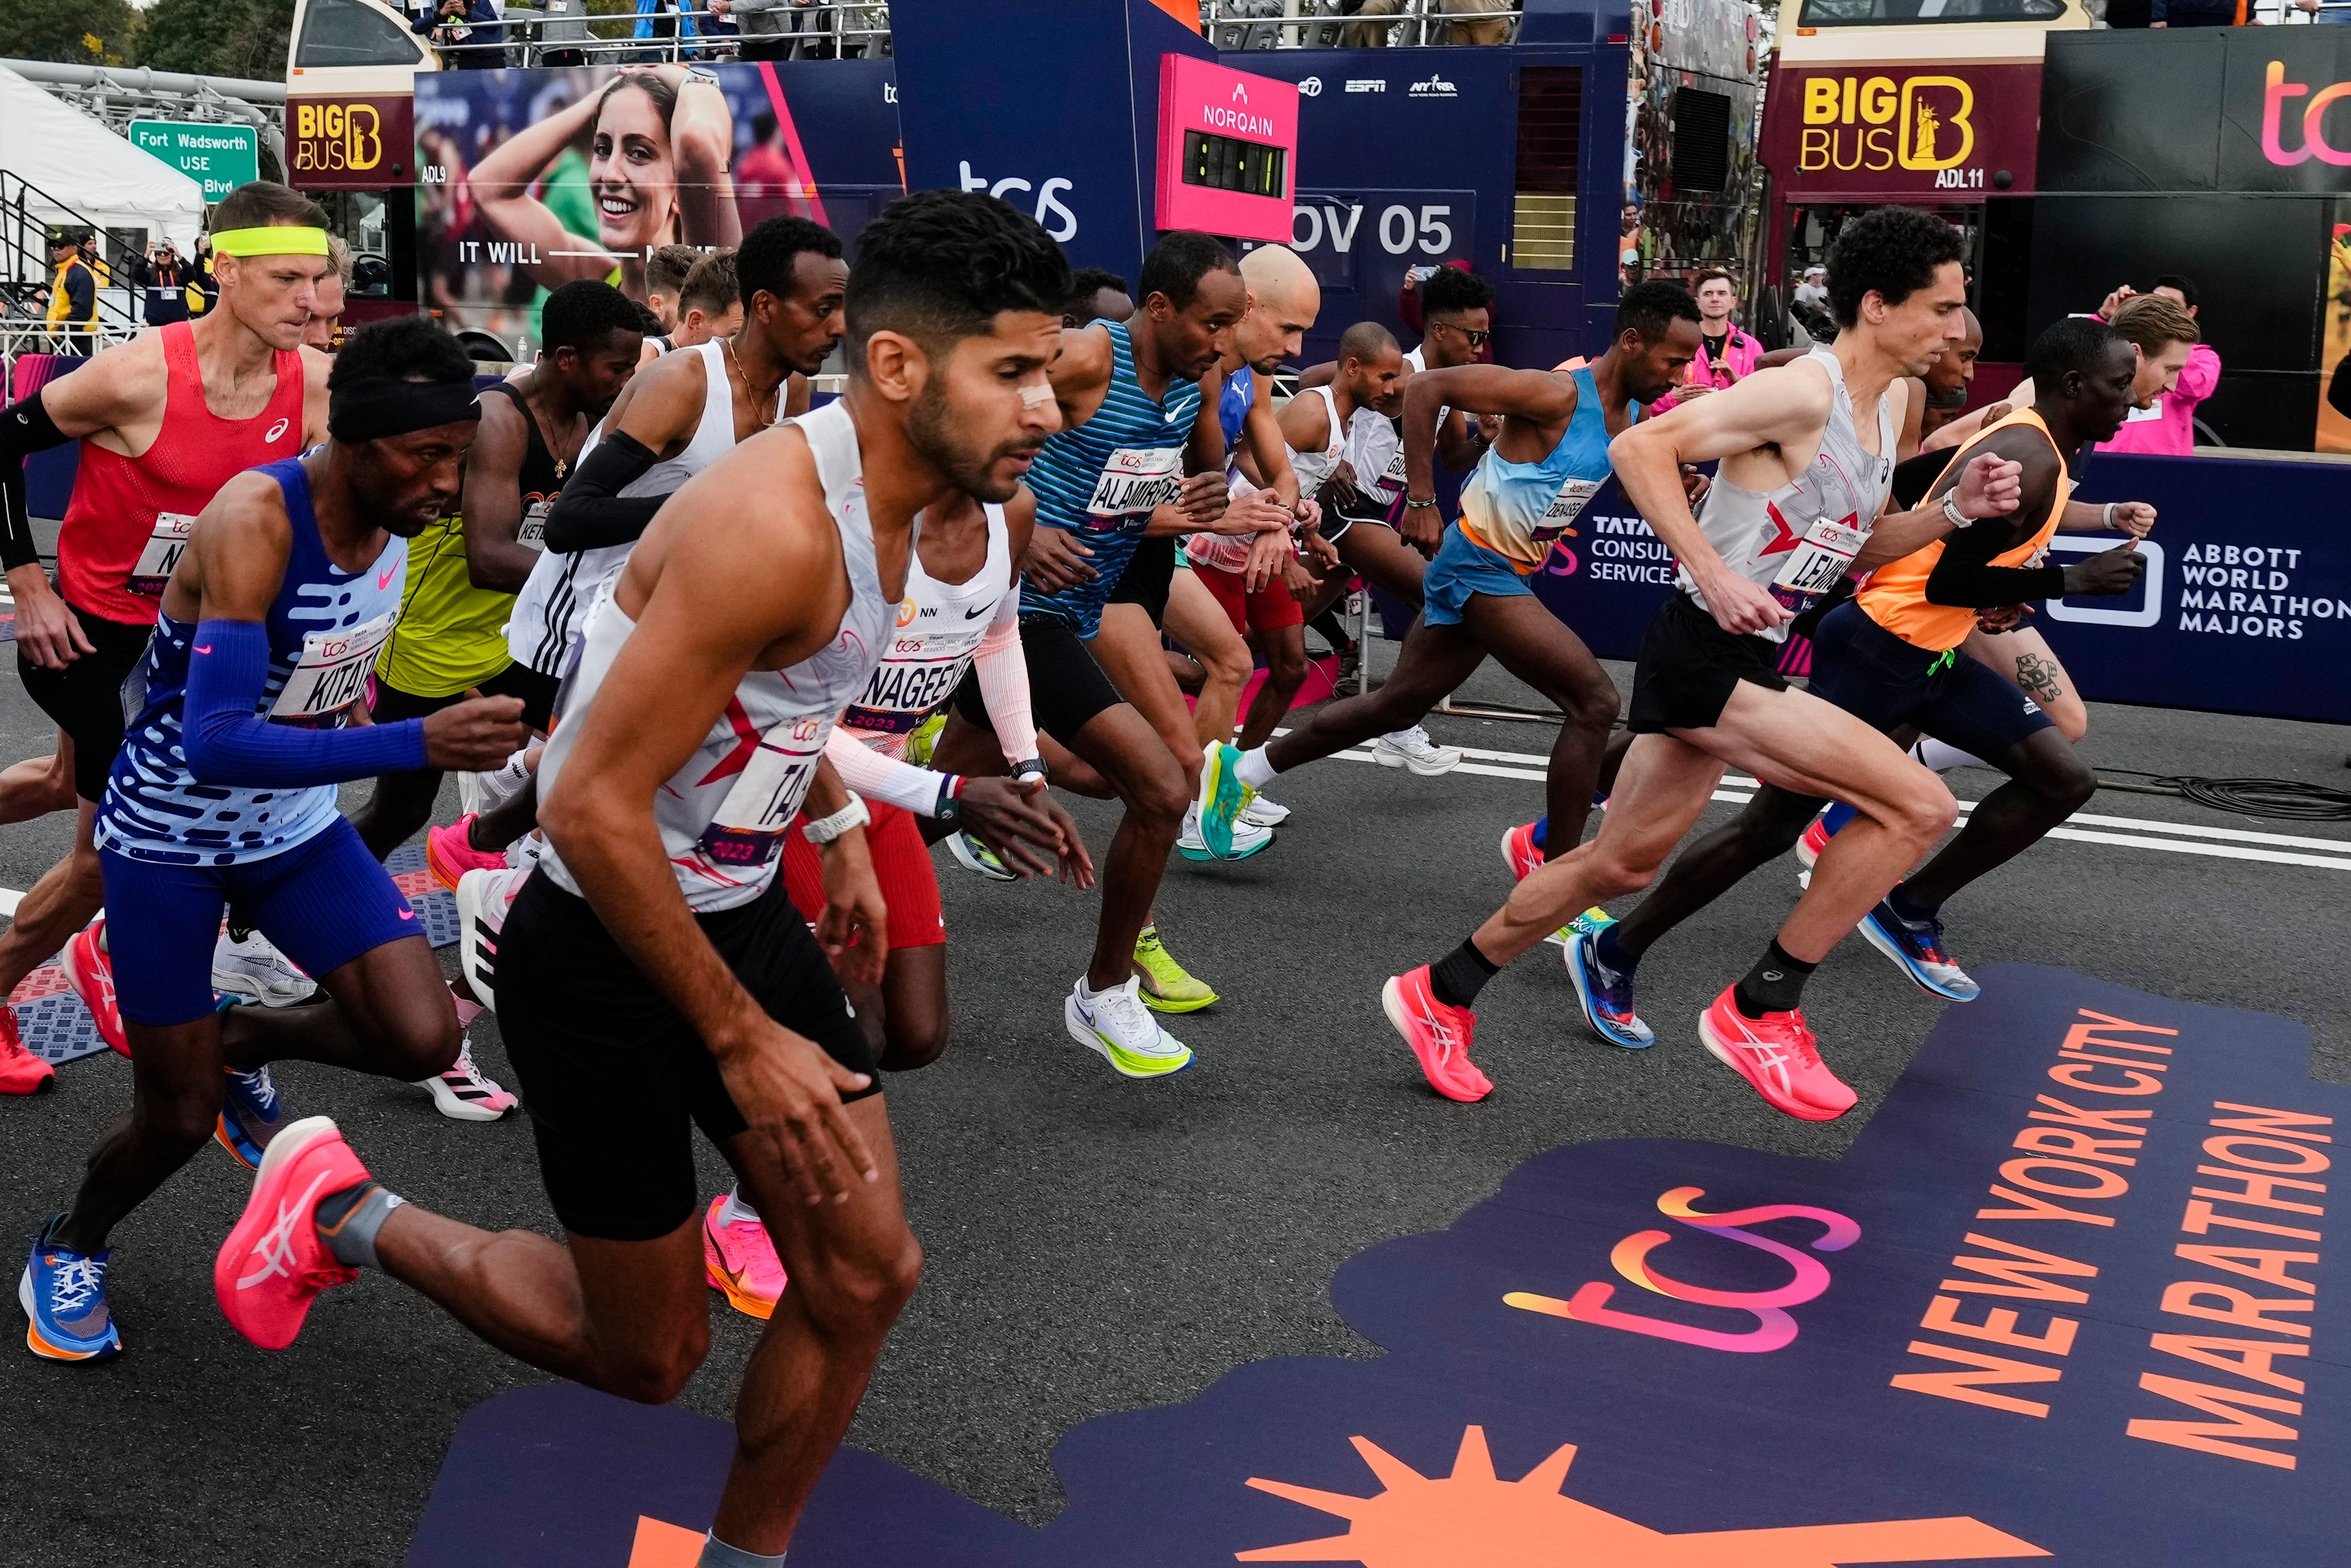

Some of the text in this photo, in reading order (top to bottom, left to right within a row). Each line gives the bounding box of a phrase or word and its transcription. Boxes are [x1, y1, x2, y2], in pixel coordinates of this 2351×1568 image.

[1345, 79, 1386, 93] ESPN
[1803, 77, 1897, 124] BIG
[298, 104, 344, 138] BIG
[1204, 104, 1273, 137] NORQAIN
[139, 131, 248, 150] Fort Wadsworth
[1800, 128, 1894, 171] BUS
[180, 156, 210, 171] USE
[296, 140, 345, 170] BUS
[204, 178, 233, 193] Blvd
[421, 165, 446, 184] ADL9
[1934, 168, 1984, 189] ADL11
[1243, 204, 1452, 255] OV 05
[459, 241, 542, 265] IT WILL
[1592, 515, 1656, 537] TATA
[1591, 539, 1674, 562] CONSUL
[2182, 543, 2302, 569] ABBOTT
[1589, 562, 1676, 584] SERVICE
[2181, 565, 2289, 591] WORLD
[920, 608, 938, 618] NN
[2180, 588, 2351, 620] MARATHON
[2179, 611, 2304, 640] MAJORS
[322, 639, 350, 658] tcs
[895, 637, 924, 653] tcs
[854, 715, 896, 730] 2023
[1890, 1007, 2179, 1418] NEW YORK CITY
[1502, 1186, 1861, 1353] tcs
[2125, 1100, 2333, 1471] MARATHON
